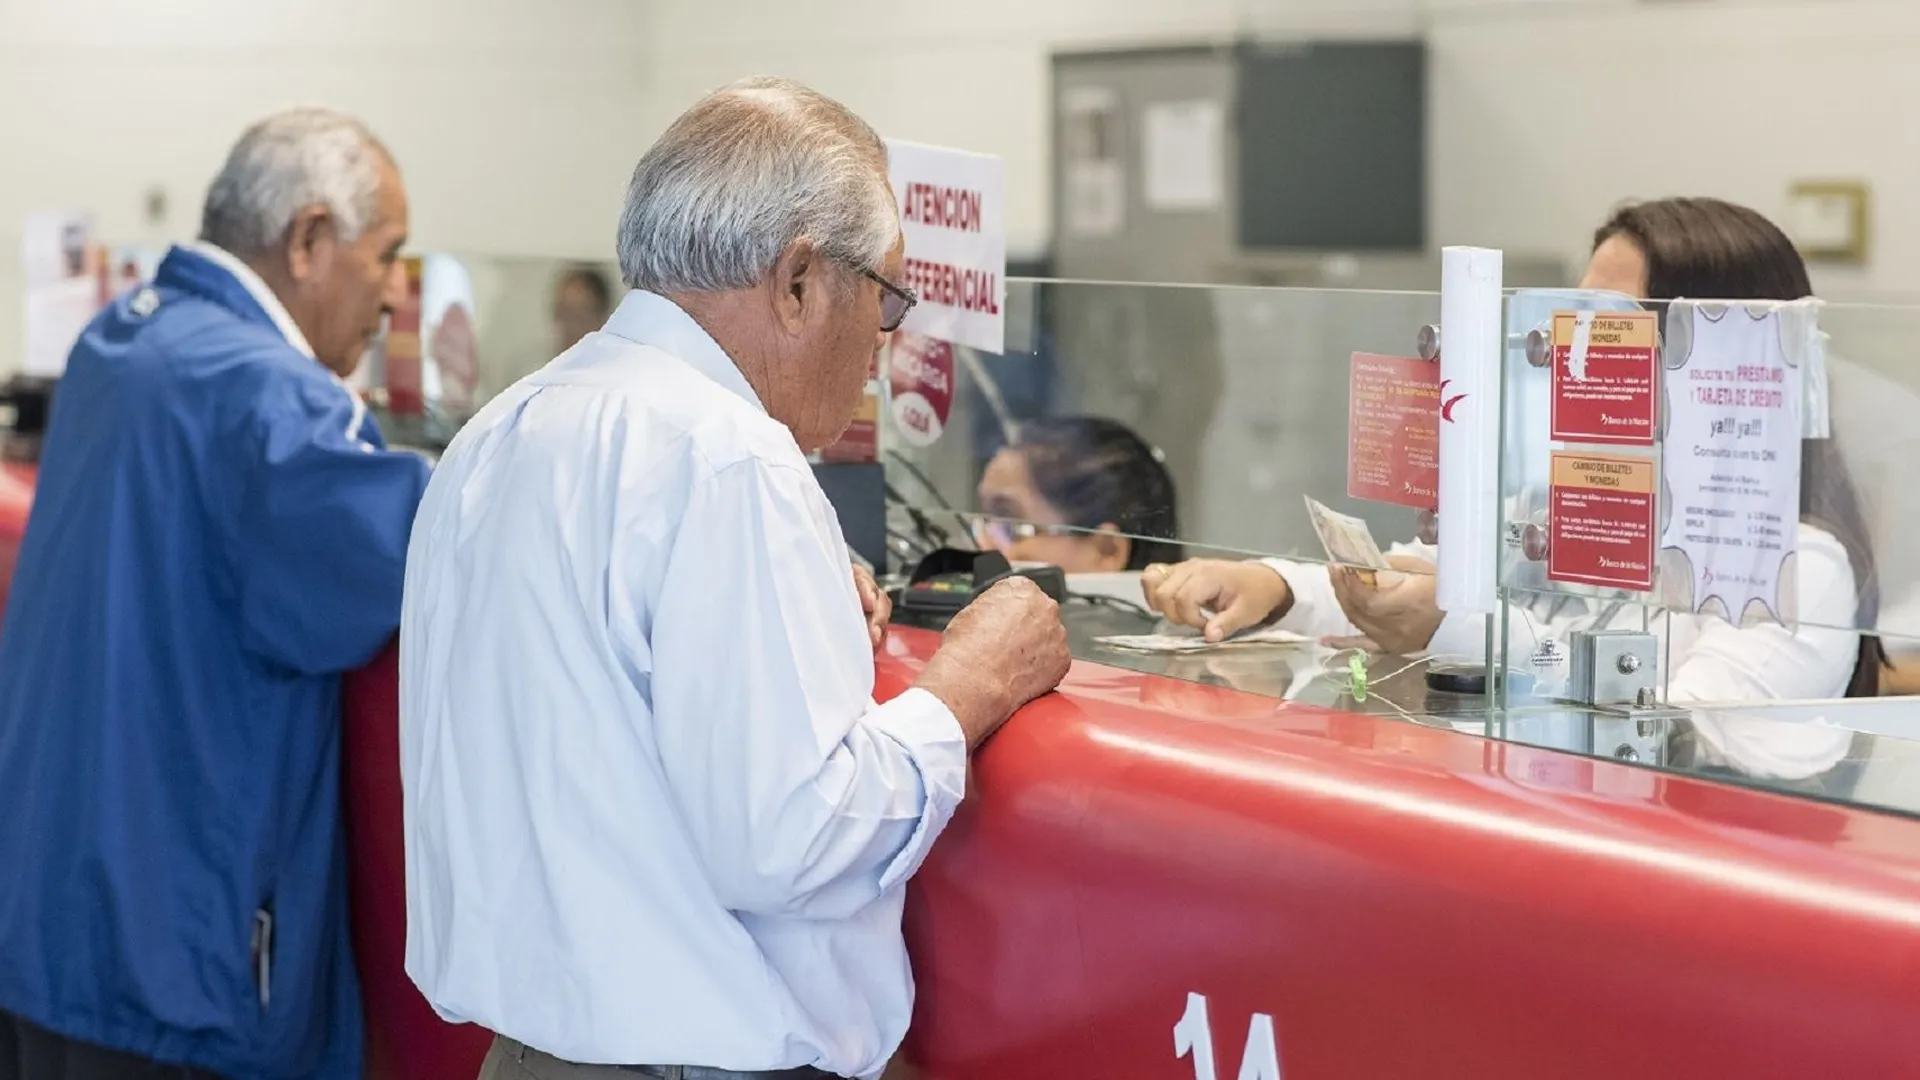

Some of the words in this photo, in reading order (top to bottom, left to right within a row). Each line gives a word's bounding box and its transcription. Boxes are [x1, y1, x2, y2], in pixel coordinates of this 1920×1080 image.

[904, 182, 981, 233] ATENCION
[1608, 321, 1633, 331] BILLETES
[1696, 387, 1733, 406] TARJETA
[1736, 388, 1747, 407] DE
[1606, 463, 1633, 475] BILLETES
[1589, 475, 1620, 487] MONEDAS
